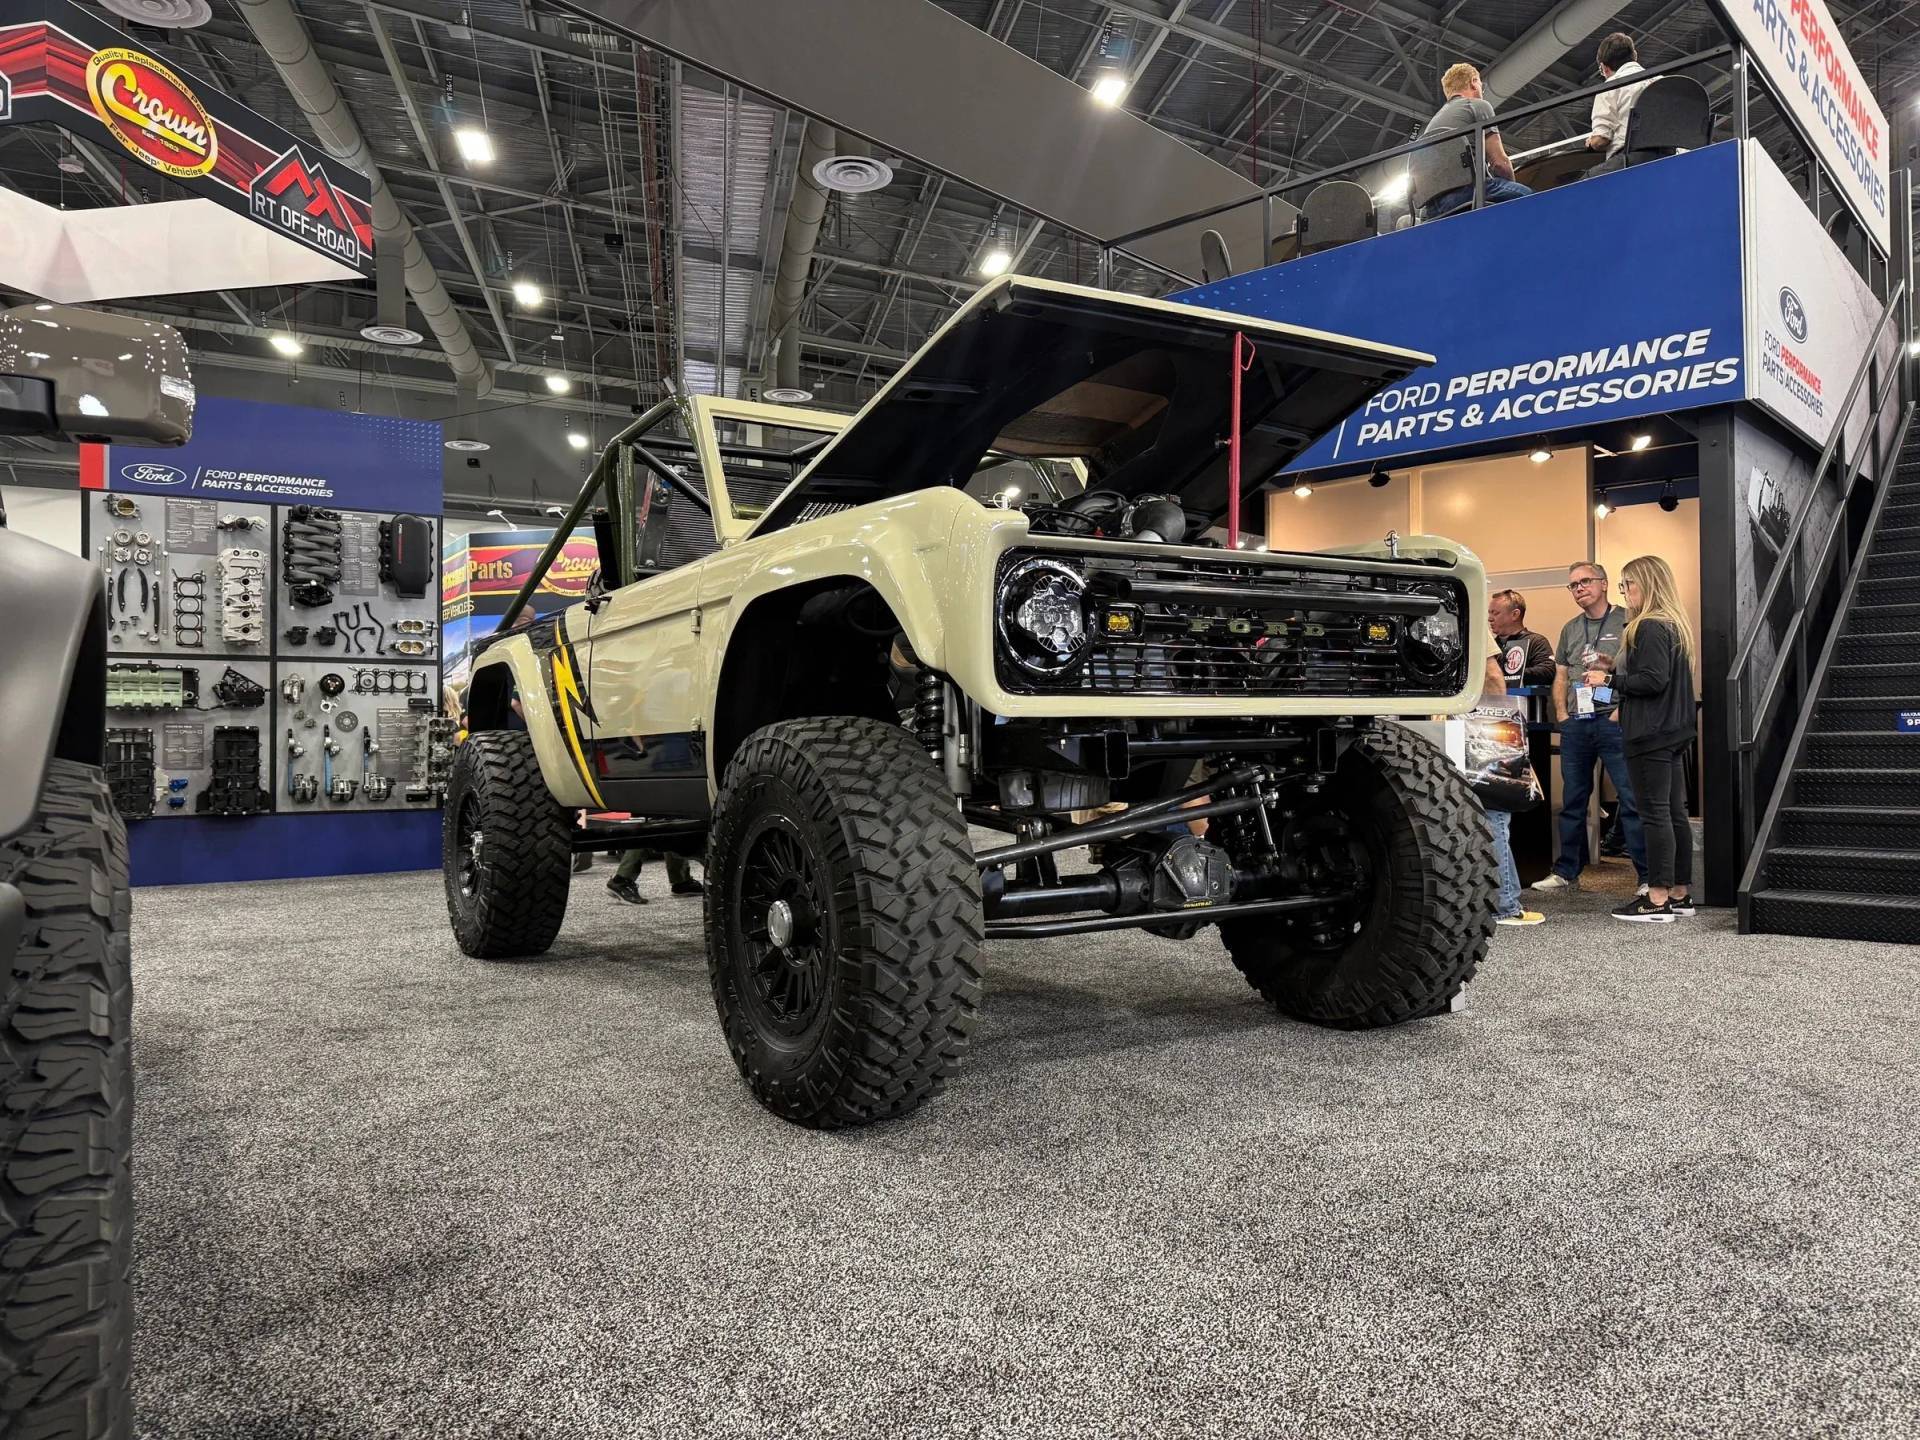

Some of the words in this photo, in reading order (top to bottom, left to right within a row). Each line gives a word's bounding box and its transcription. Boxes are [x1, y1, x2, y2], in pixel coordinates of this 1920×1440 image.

[92, 49, 124, 66] Quality
[127, 51, 190, 95] Replacement
[190, 94, 213, 129] Parts
[101, 63, 208, 156] Crown
[108, 122, 129, 144] For
[163, 162, 204, 176] Vehicles
[1799, 50, 1809, 96] &
[1811, 74, 1885, 218] ACCESSORIES
[255, 191, 277, 219] RT
[280, 205, 355, 259] OFF-ROAD
[1784, 294, 1804, 336] Ford
[1364, 383, 1441, 417] FORD
[1445, 328, 1712, 402] PERFORMANCE
[1762, 352, 1784, 385] PARTS
[1785, 372, 1823, 418] ACCESSORIES
[1764, 330, 1780, 358] FORD
[1780, 345, 1822, 395] PERFORMANCE
[1356, 408, 1455, 447] PARTS
[1460, 403, 1484, 427] &
[1488, 357, 1740, 424] ACCESSORIES
[133, 465, 175, 482] Ford
[201, 479, 242, 491] PARTS
[243, 483, 253, 491] &
[254, 483, 334, 498] ACCESSORIES
[204, 469, 236, 480] FORD
[238, 473, 326, 488] PERFORMANCE
[468, 560, 513, 581] Parts
